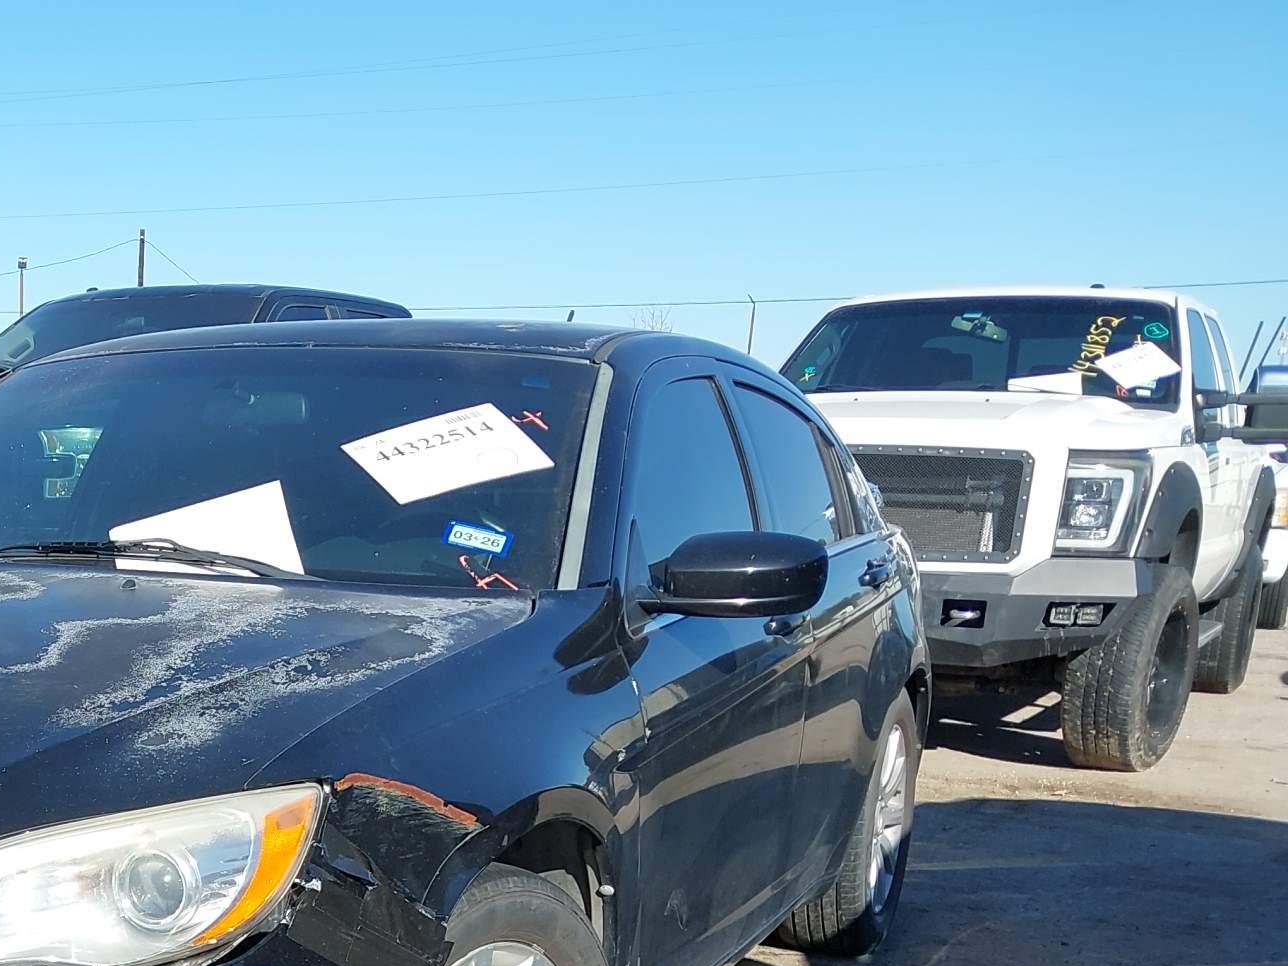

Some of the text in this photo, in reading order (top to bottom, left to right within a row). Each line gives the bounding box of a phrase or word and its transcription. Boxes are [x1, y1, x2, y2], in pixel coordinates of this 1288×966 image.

[376, 421, 494, 462] 44322514
[453, 530, 500, 548] 03 26
